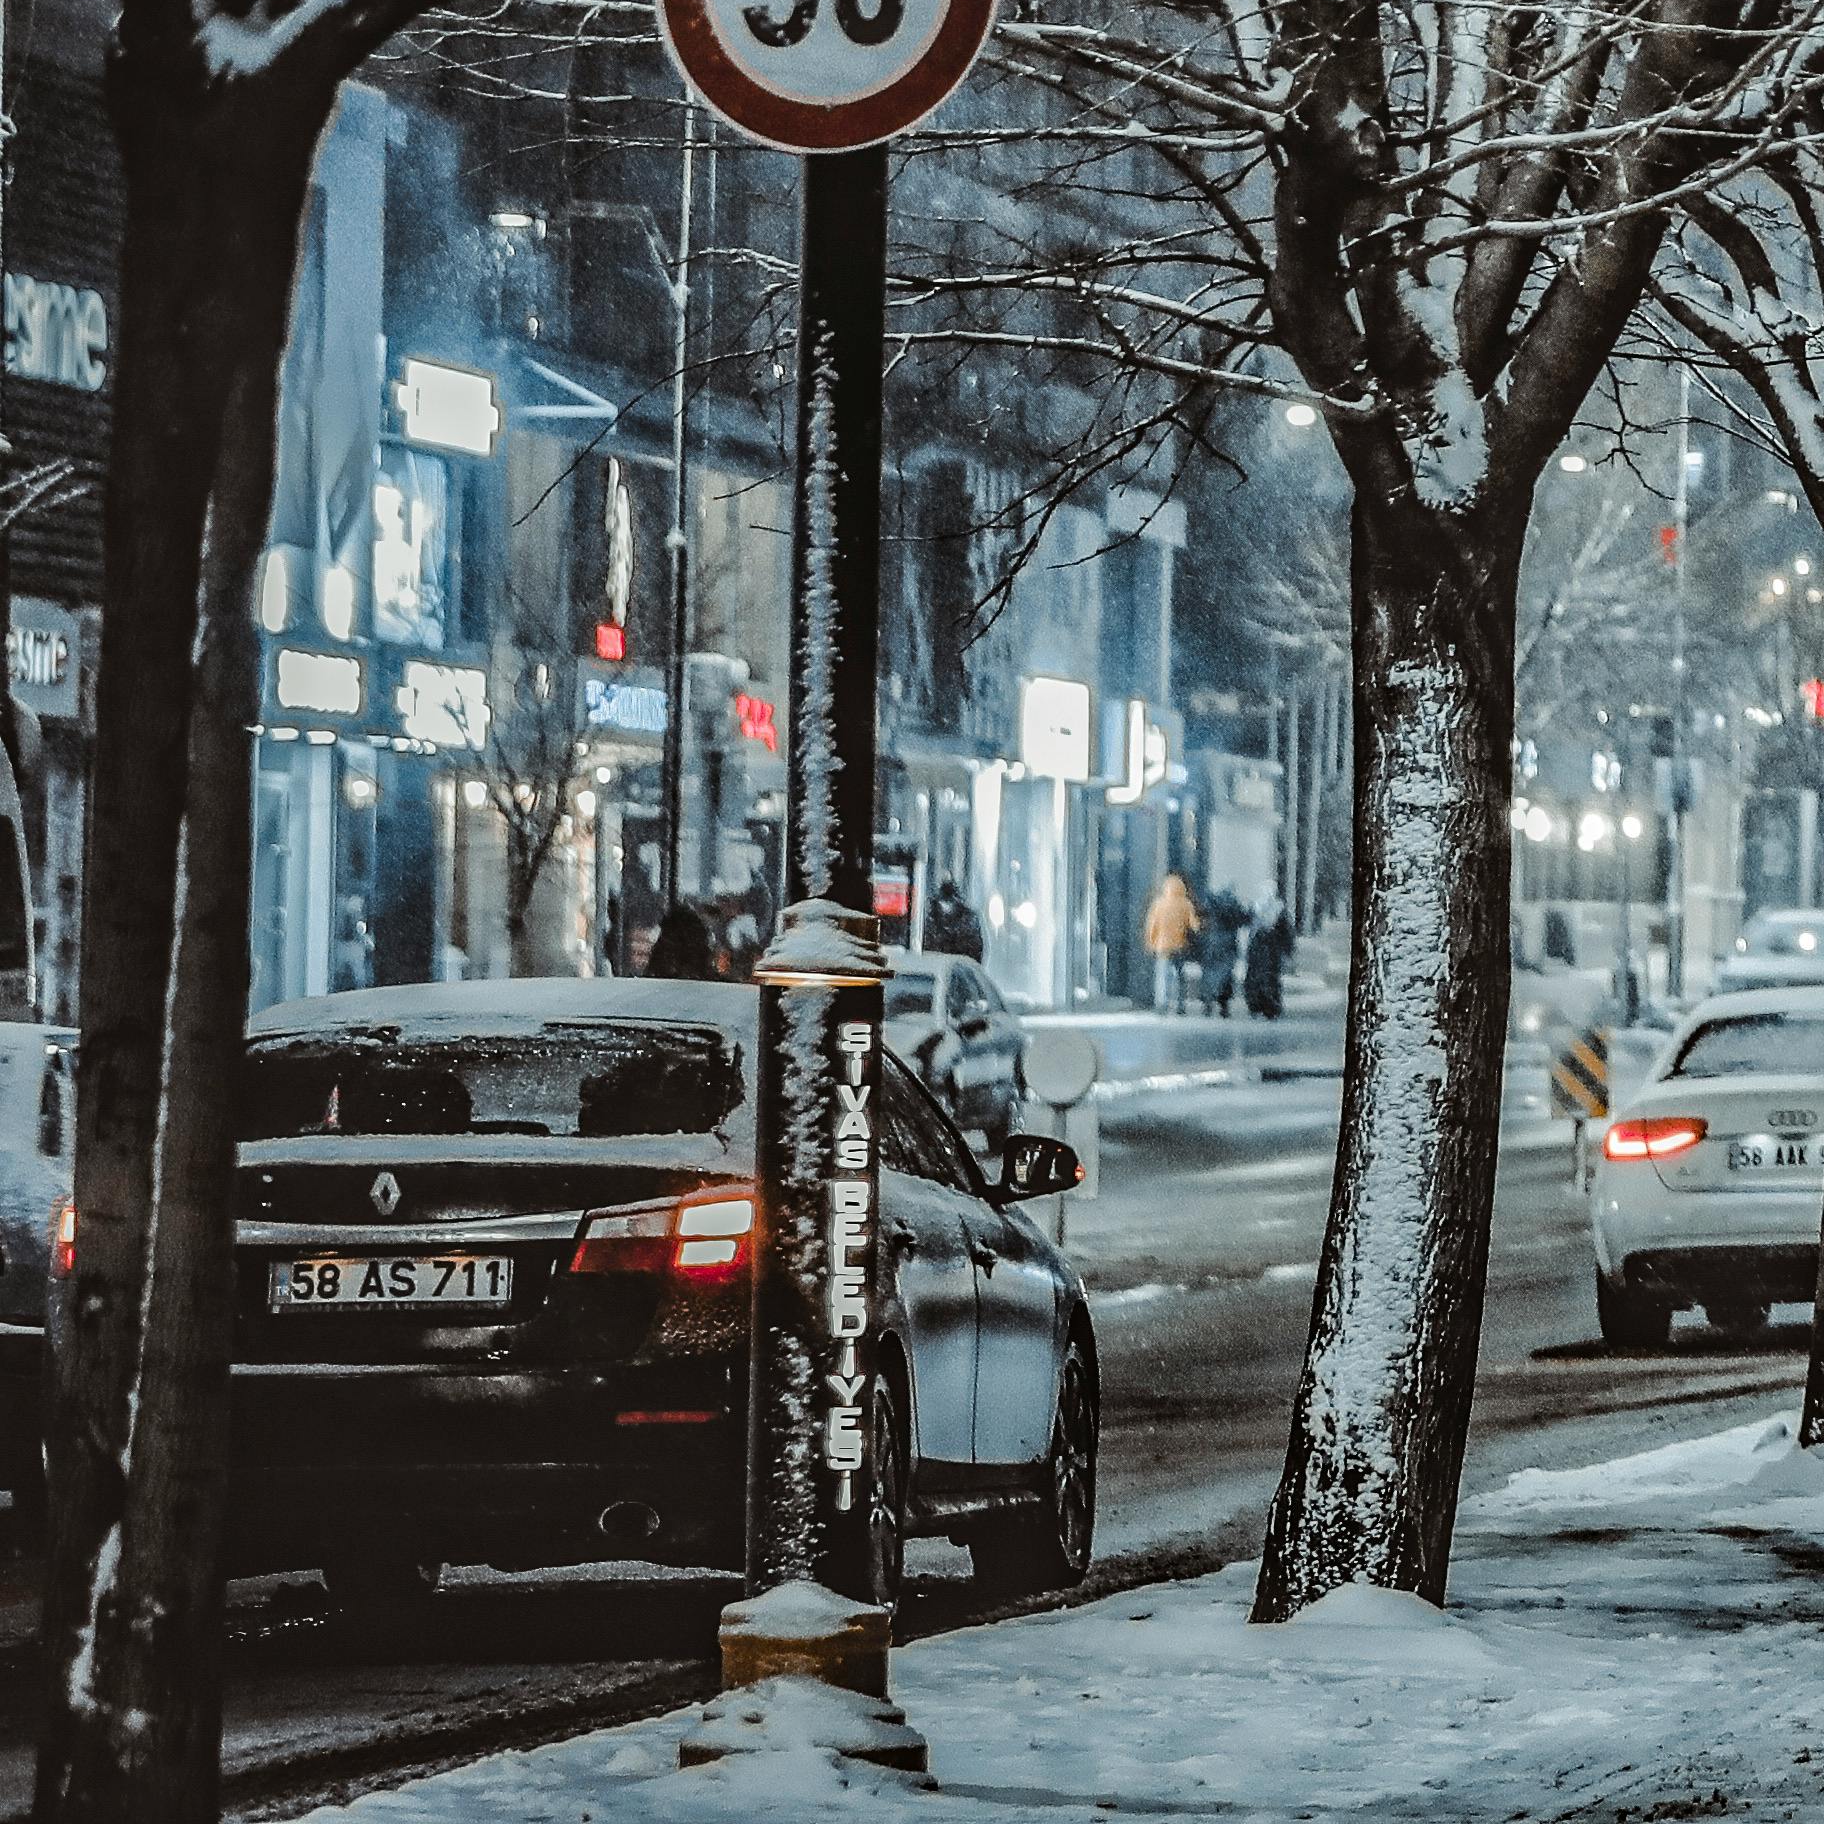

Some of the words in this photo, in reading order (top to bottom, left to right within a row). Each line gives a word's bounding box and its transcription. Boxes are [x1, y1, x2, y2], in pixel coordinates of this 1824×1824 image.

[291, 1262, 341, 1300] 58
[358, 1259, 417, 1298] AS
[432, 1259, 501, 1297] 711
